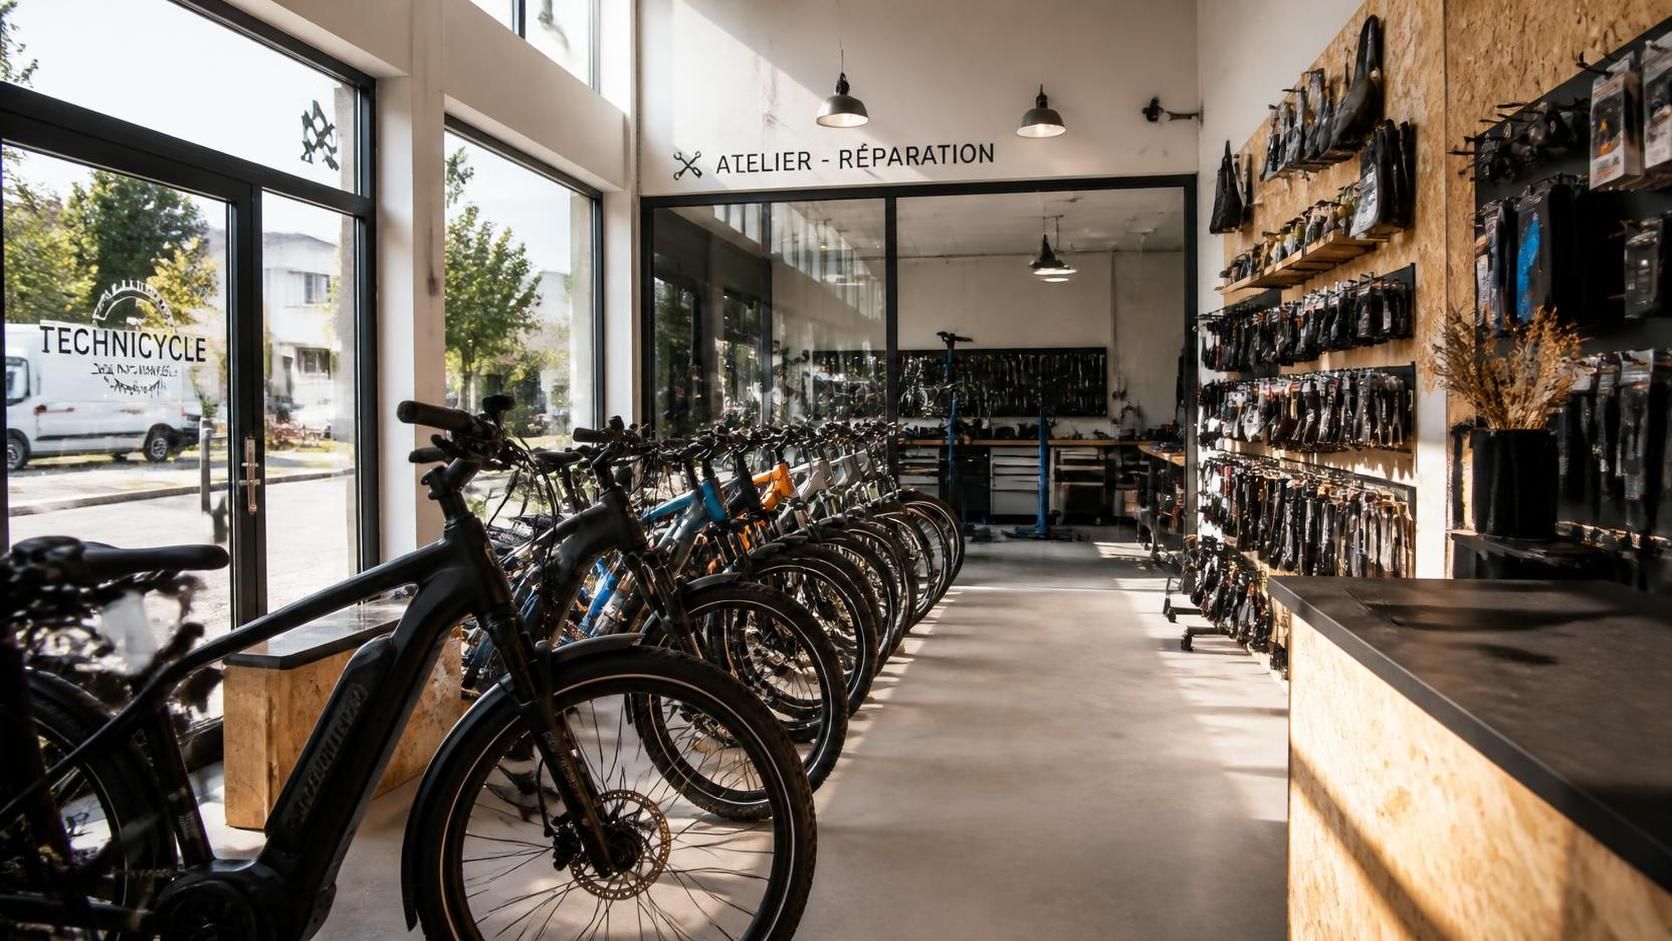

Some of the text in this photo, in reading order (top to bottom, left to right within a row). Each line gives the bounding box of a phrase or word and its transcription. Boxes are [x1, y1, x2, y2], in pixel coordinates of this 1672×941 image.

[716, 151, 812, 174] ATELIER
[839, 142, 995, 169] RÉPARATION
[39, 325, 206, 362] TECHNICYCLE
